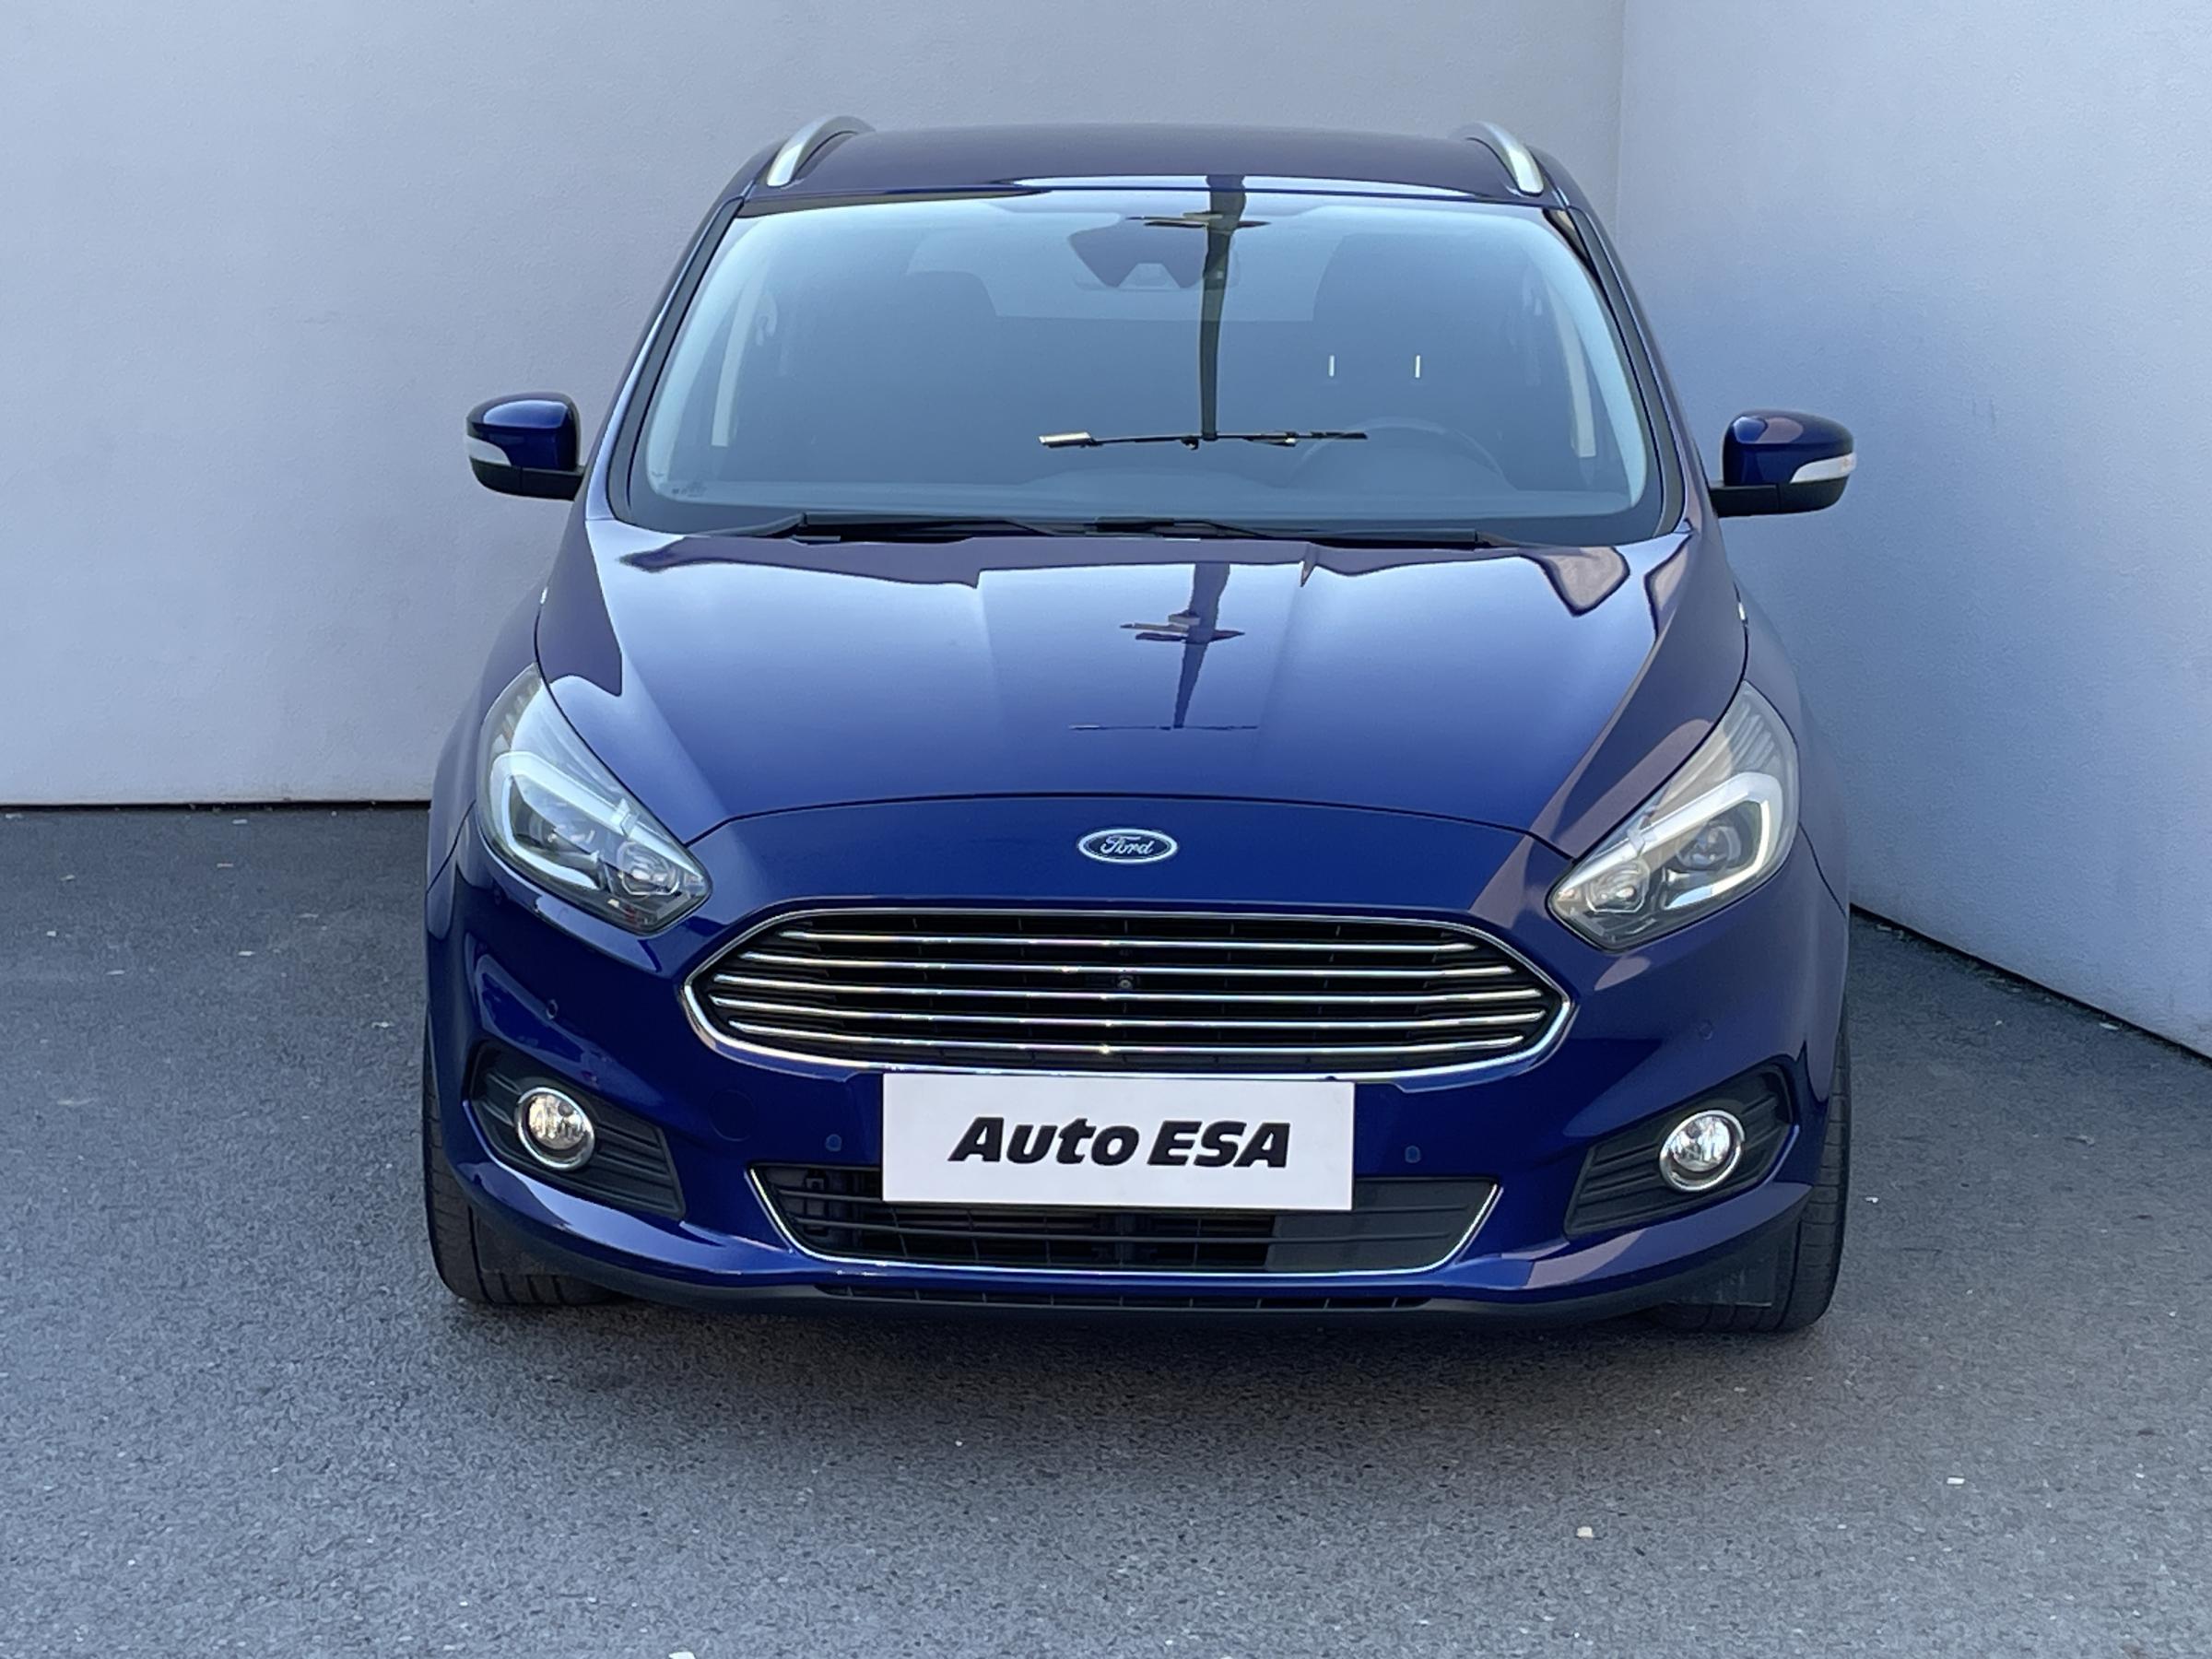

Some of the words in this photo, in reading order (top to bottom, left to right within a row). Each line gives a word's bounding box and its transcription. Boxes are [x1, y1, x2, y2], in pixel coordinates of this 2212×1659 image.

[1100, 835, 1155, 854] Ford
[947, 1116, 1139, 1166] Auto
[1147, 1121, 1290, 1168] ESA
